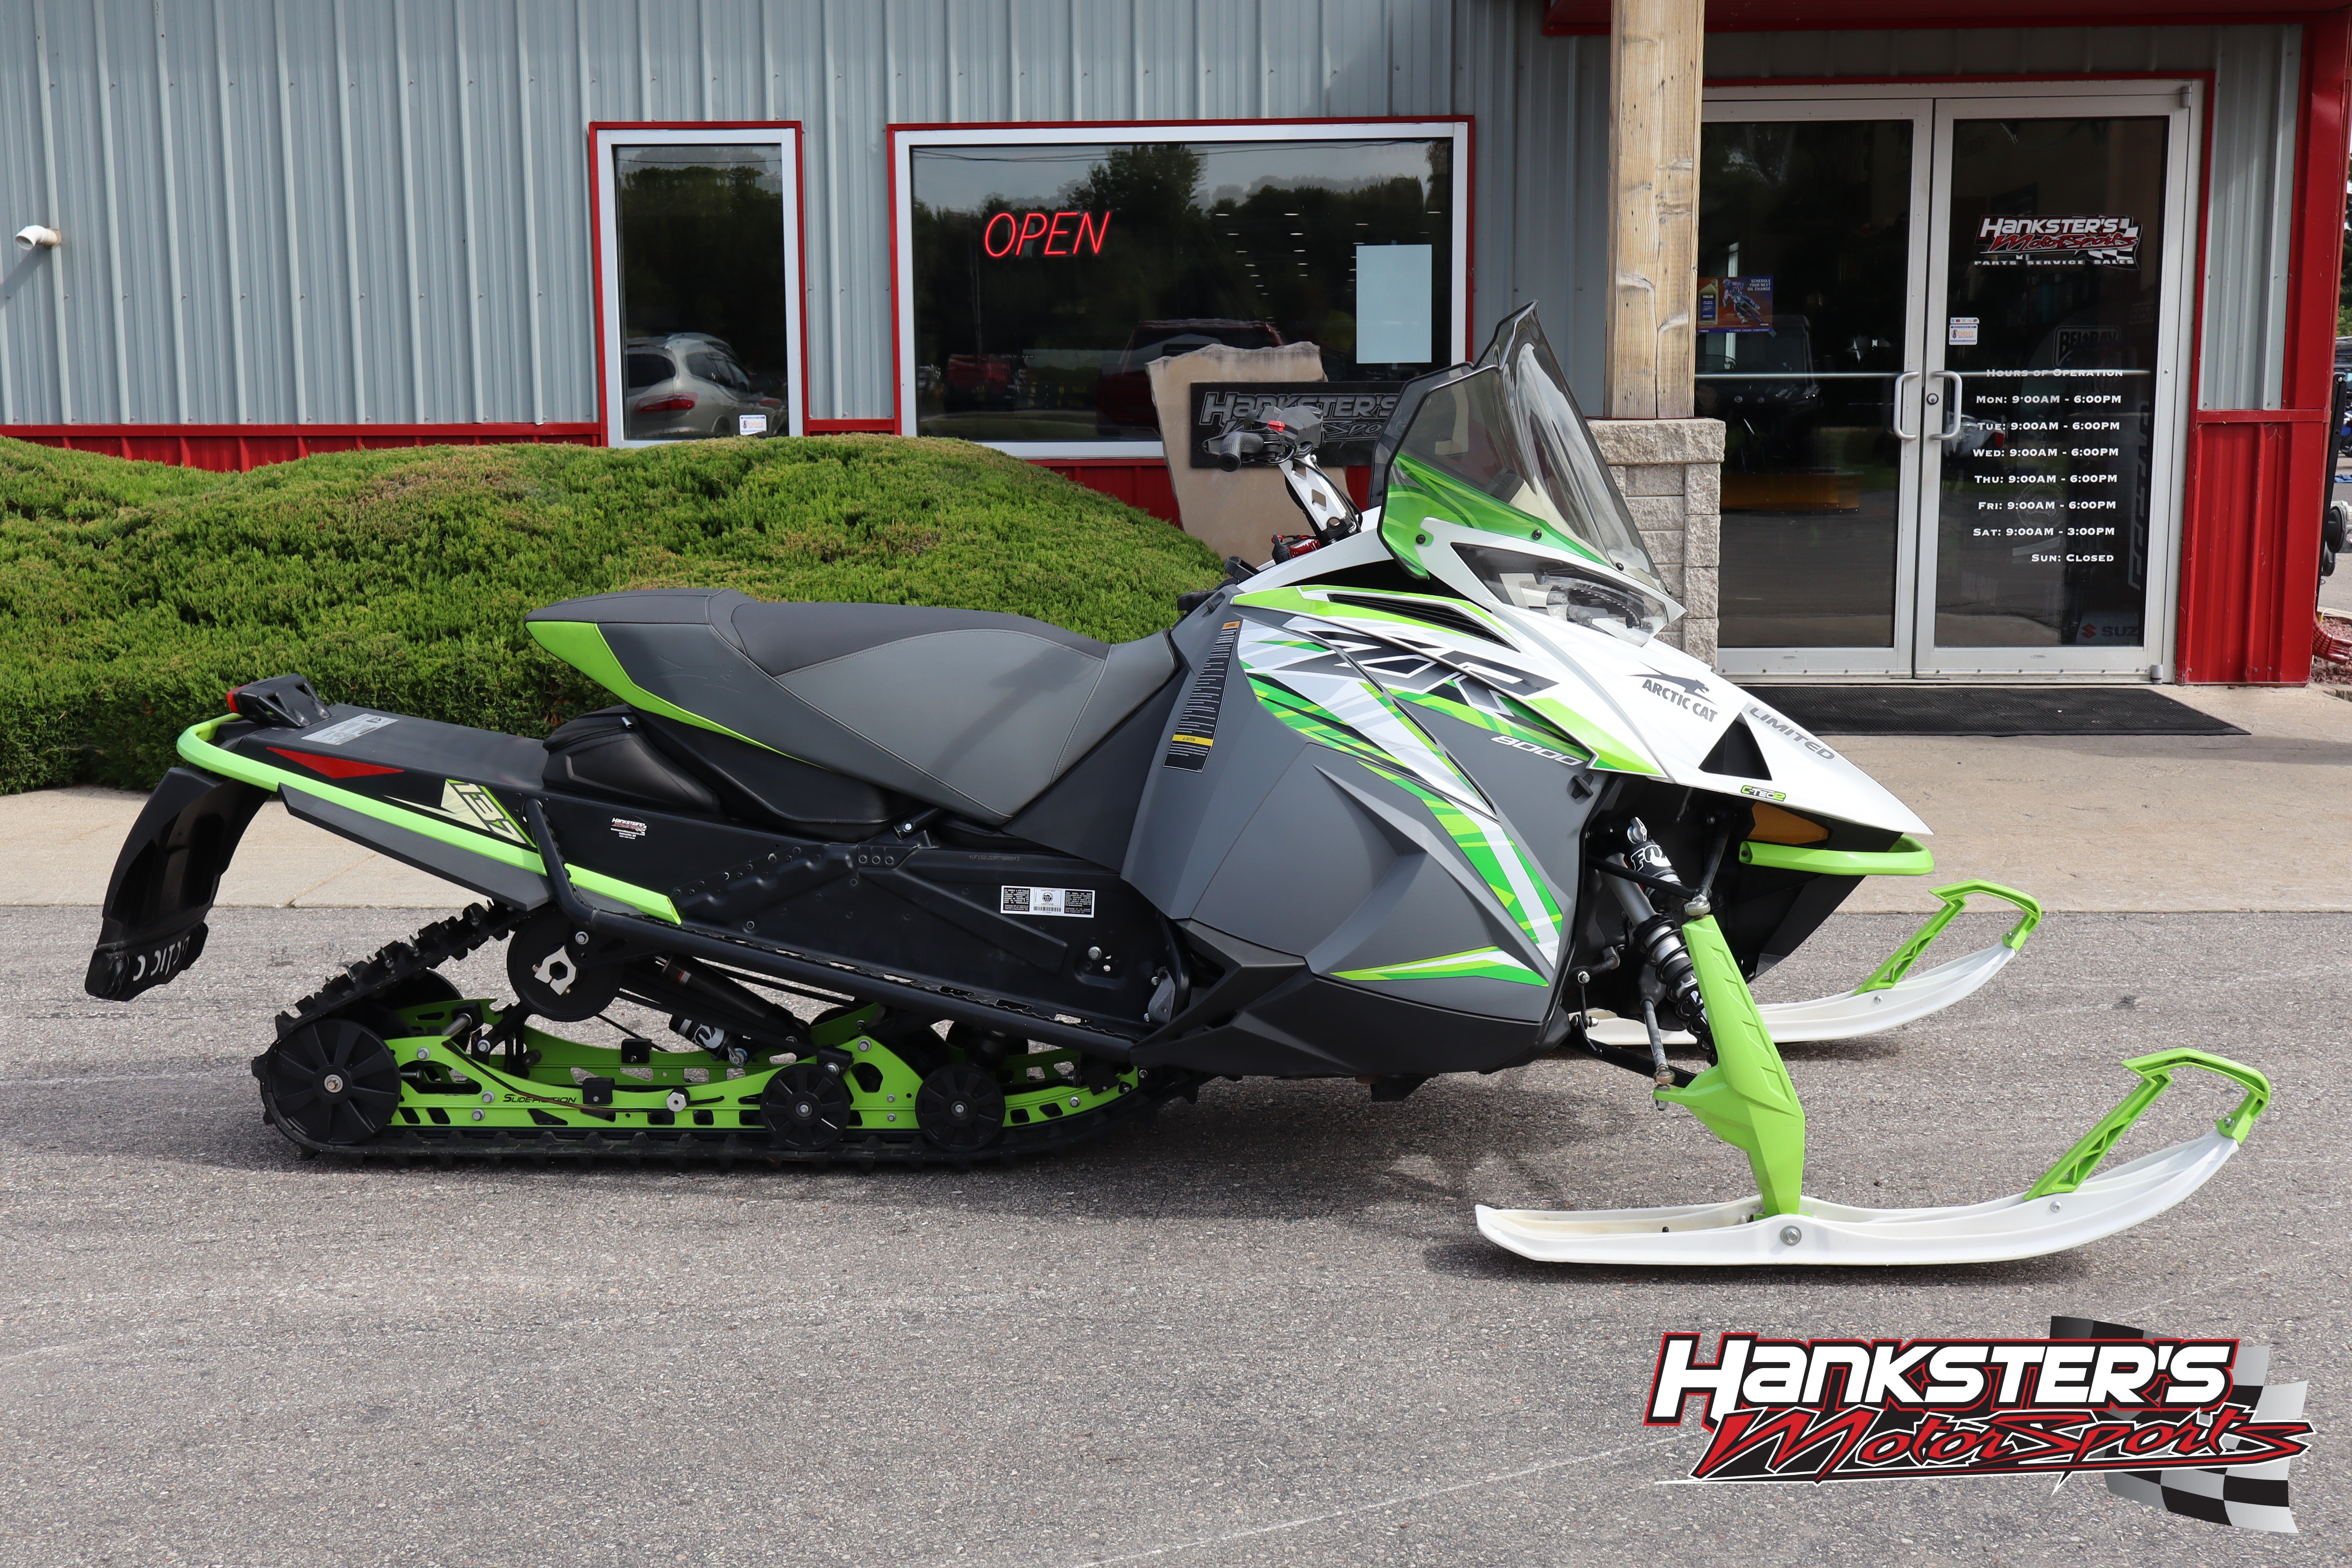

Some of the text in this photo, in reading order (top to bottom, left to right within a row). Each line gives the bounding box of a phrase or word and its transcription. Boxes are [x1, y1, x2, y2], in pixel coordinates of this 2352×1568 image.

[984, 211, 1111, 258] OPEN
[2012, 395, 2060, 403] 9:00AM
[2074, 395, 2121, 403] 6:00PM
[2011, 422, 2058, 430] 9:00AM
[2072, 422, 2120, 430] 6:00PM
[2009, 448, 2057, 457] 9:00AM
[2071, 448, 2118, 456] 6:00PM
[2008, 475, 2056, 483] 9:00AM
[2070, 474, 2117, 483] 6:00PM
[2007, 501, 2055, 510] 9:00AM
[2069, 501, 2116, 509] 6:00PM
[2006, 528, 2054, 536] 9:00AM
[2067, 527, 2114, 535] 3:00PM
[1642, 679, 1718, 722] ARCTIC CAT
[1749, 707, 1836, 760] LIMITED
[1490, 735, 1584, 766] 8000
[1741, 785, 1786, 801] C-TEC2
[454, 782, 527, 844] 137
